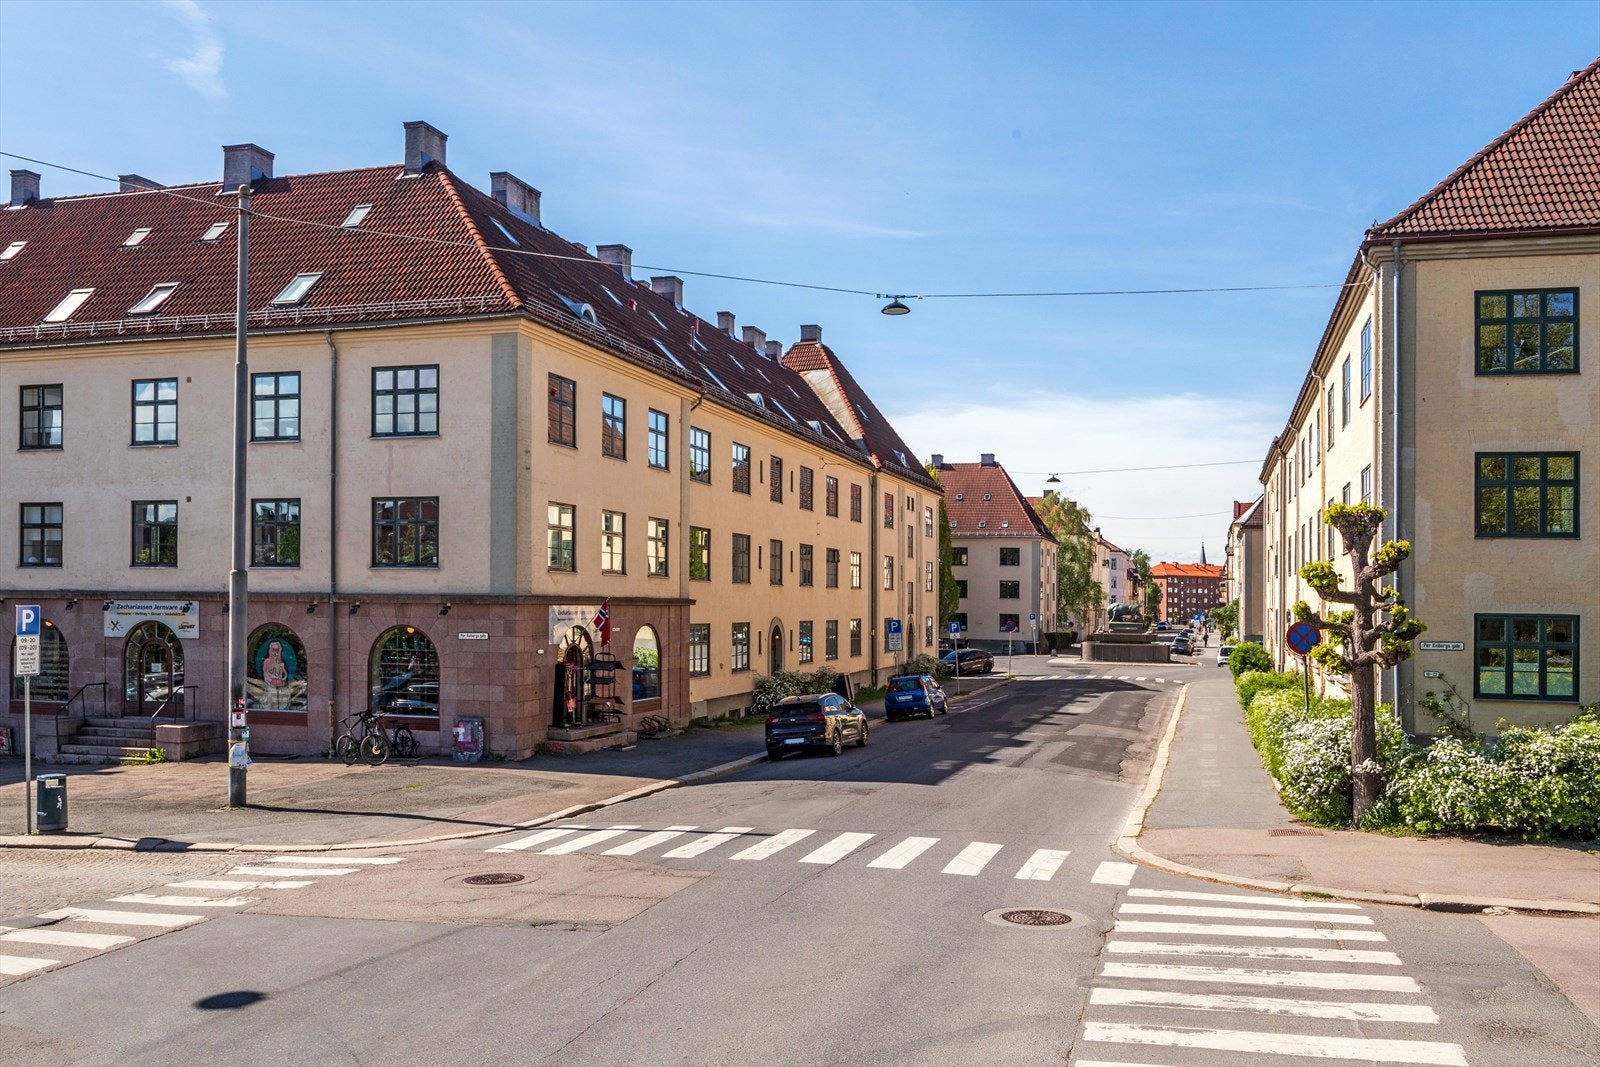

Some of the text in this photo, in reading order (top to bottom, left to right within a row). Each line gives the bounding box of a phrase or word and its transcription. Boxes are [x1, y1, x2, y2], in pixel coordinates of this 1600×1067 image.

[22, 609, 35, 632] P
[891, 621, 898, 632] P
[951, 623, 957, 632] P
